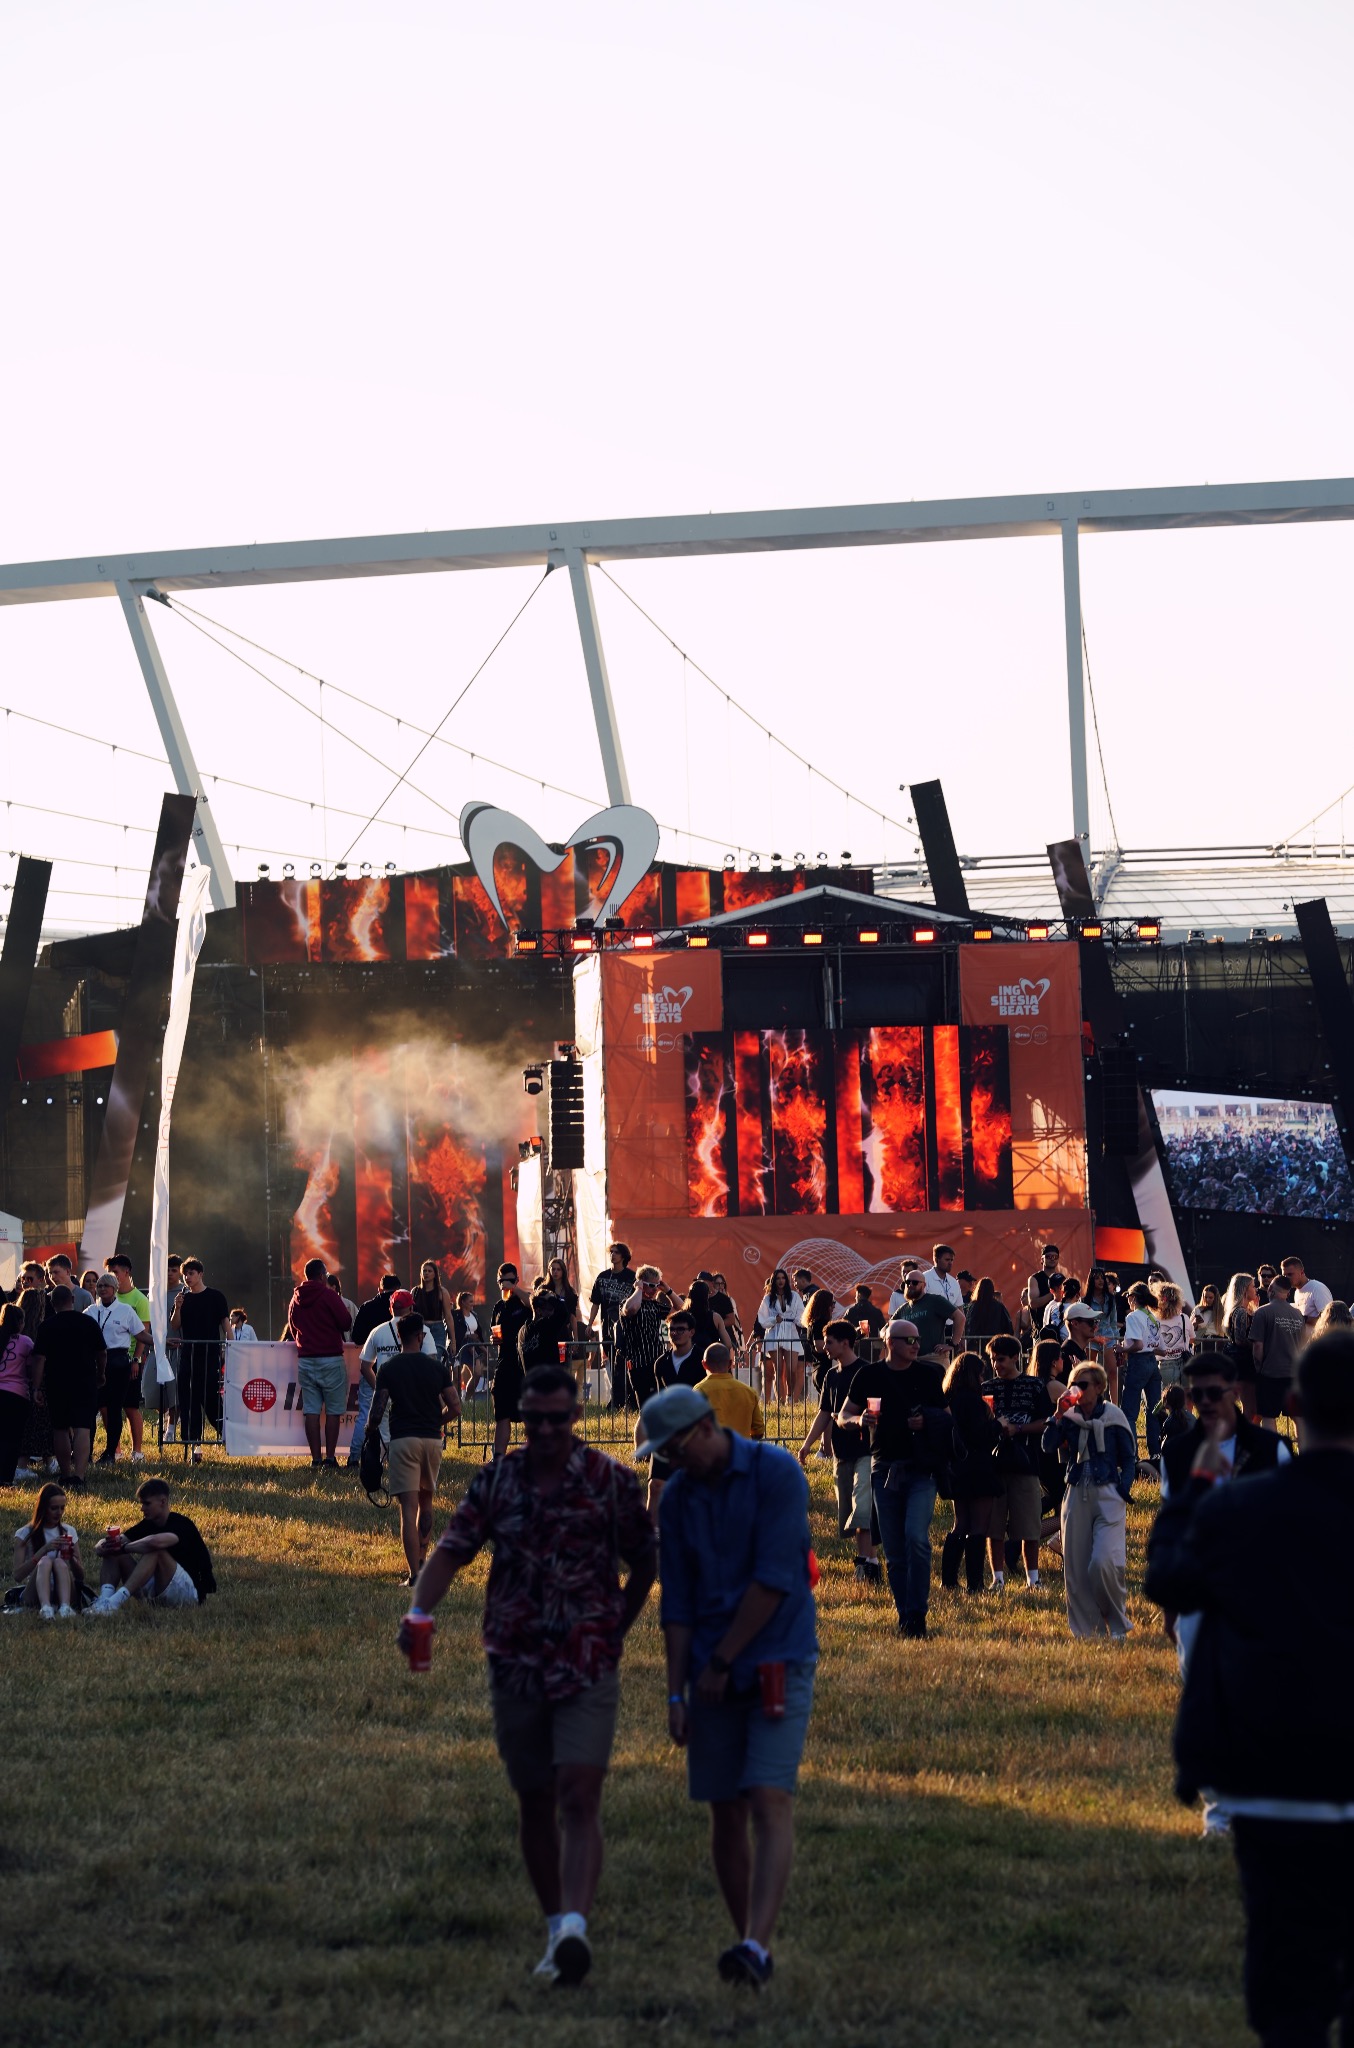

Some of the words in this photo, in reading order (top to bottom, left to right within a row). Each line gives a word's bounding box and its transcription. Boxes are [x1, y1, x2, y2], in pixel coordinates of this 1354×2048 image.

[999, 985, 1020, 995] ING
[642, 993, 664, 1003] ING
[990, 995, 1038, 1006] SILESIA
[633, 1003, 681, 1014] SILESIA
[1000, 1005, 1039, 1015] BEATS
[643, 1013, 682, 1023] BEATS
